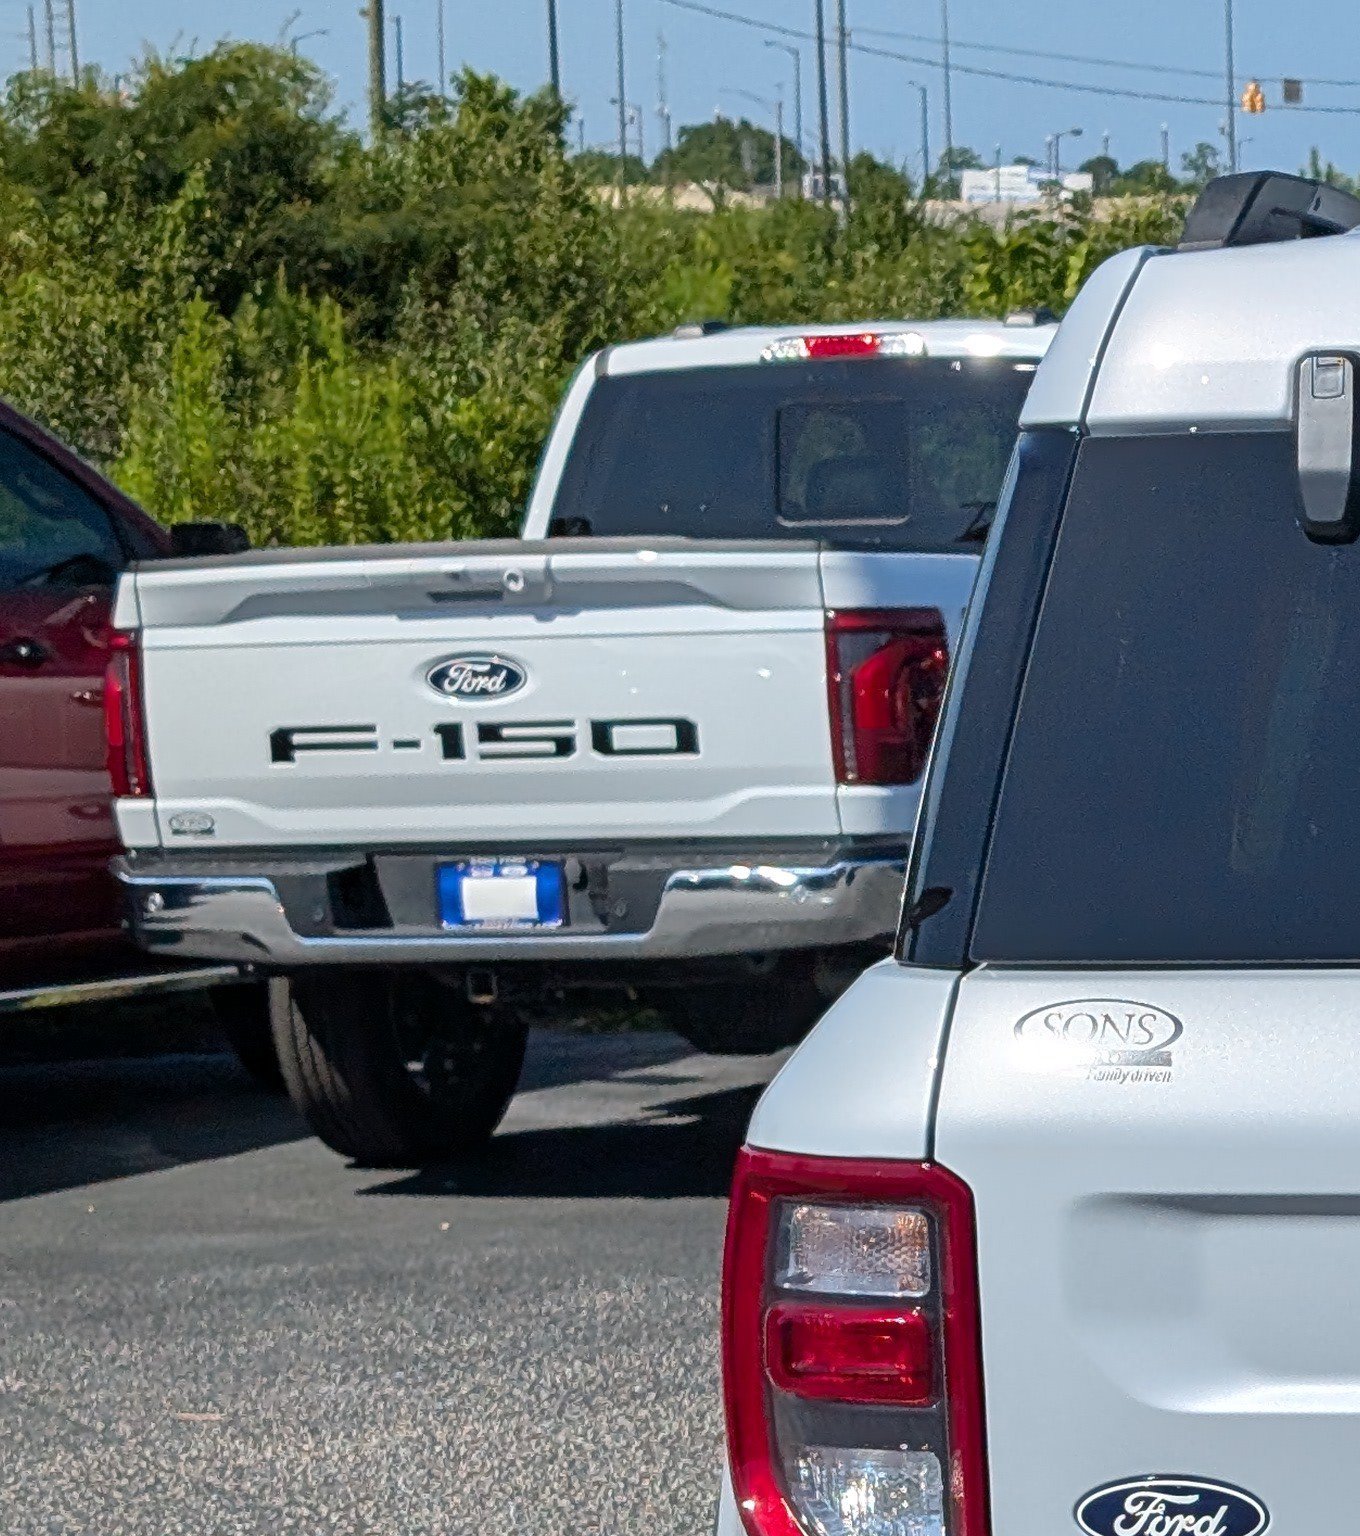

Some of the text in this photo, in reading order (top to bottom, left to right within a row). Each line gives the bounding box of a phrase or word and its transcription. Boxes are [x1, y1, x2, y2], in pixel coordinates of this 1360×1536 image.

[443, 662, 508, 693] Ford
[268, 718, 701, 764] F-150
[1044, 1012, 1157, 1045] SONS
